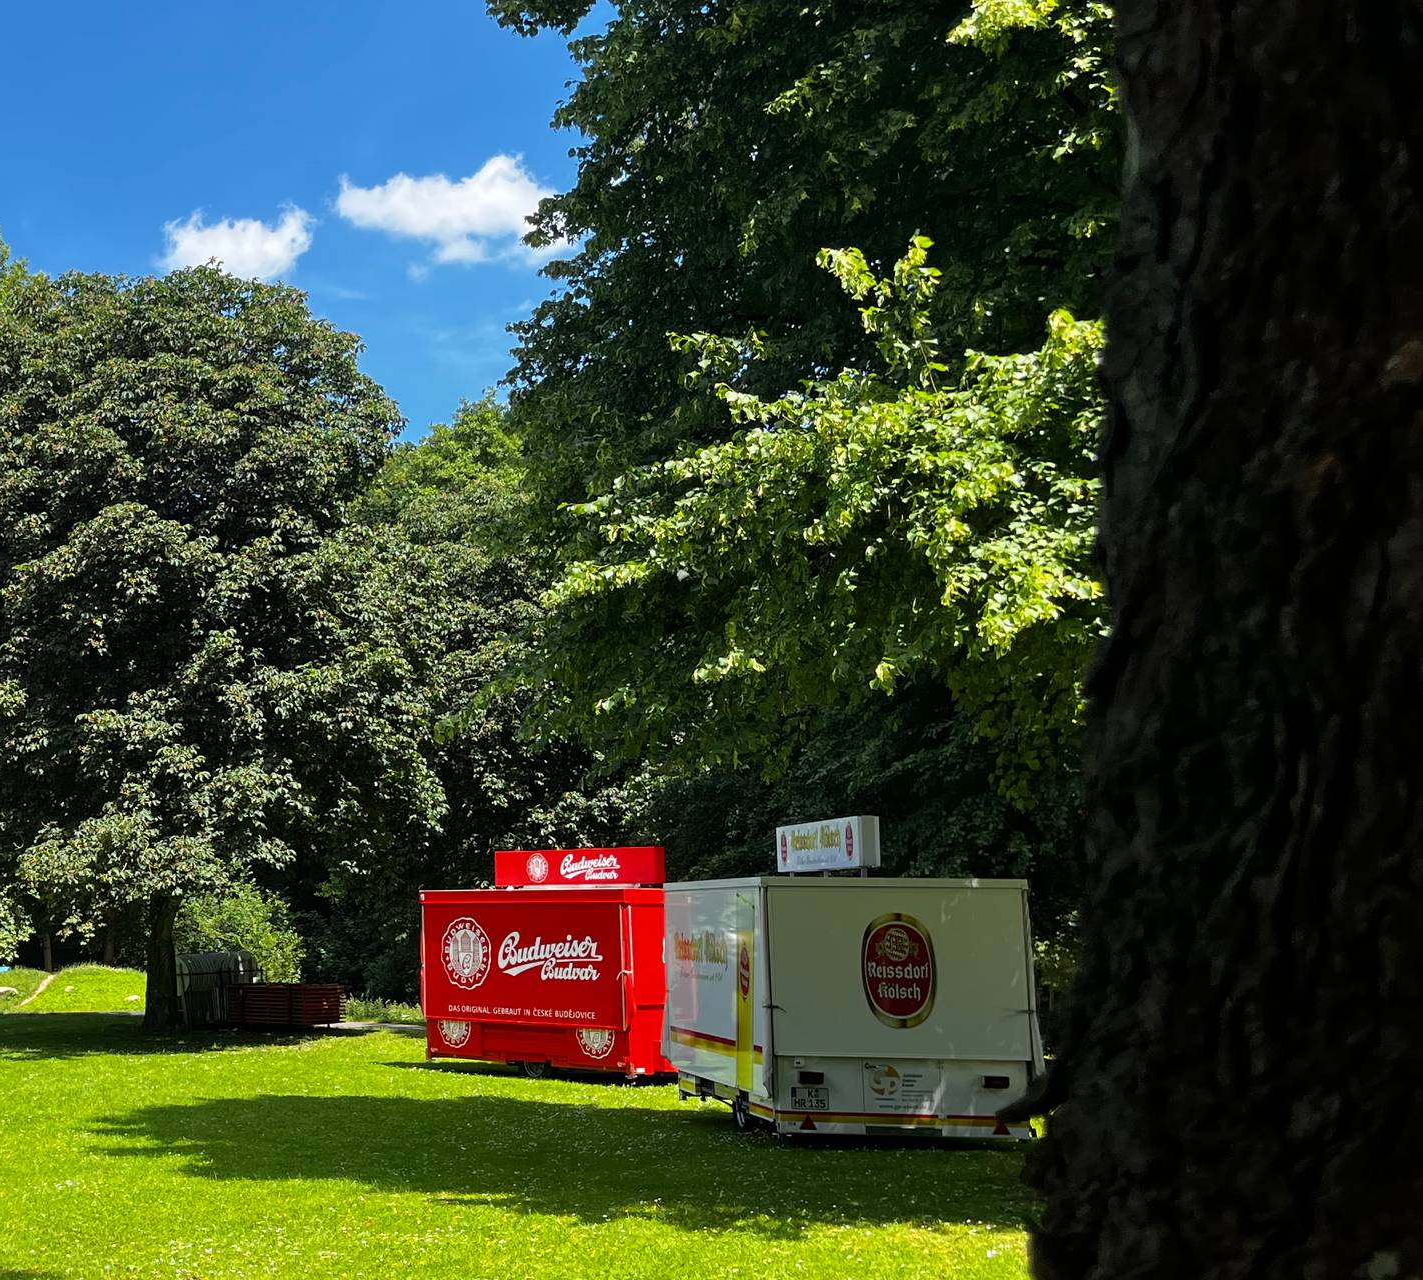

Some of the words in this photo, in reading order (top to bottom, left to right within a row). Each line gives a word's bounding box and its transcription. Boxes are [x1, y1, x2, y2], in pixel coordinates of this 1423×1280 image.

[560, 853, 621, 878] Budweiser
[585, 869, 619, 880] Budvar
[497, 931, 603, 976] Budweiser
[540, 957, 600, 980] Budvar
[867, 961, 929, 979] Reissdorf
[878, 982, 921, 1001] Kölsch
[448, 1004, 461, 1013] DAS
[493, 1006, 522, 1016] GEBRAUT
[532, 1007, 553, 1017] ČESKÉ
[807, 1089, 814, 1098] K
[793, 1098, 807, 1108] HR
[808, 1099, 826, 1109] 135
